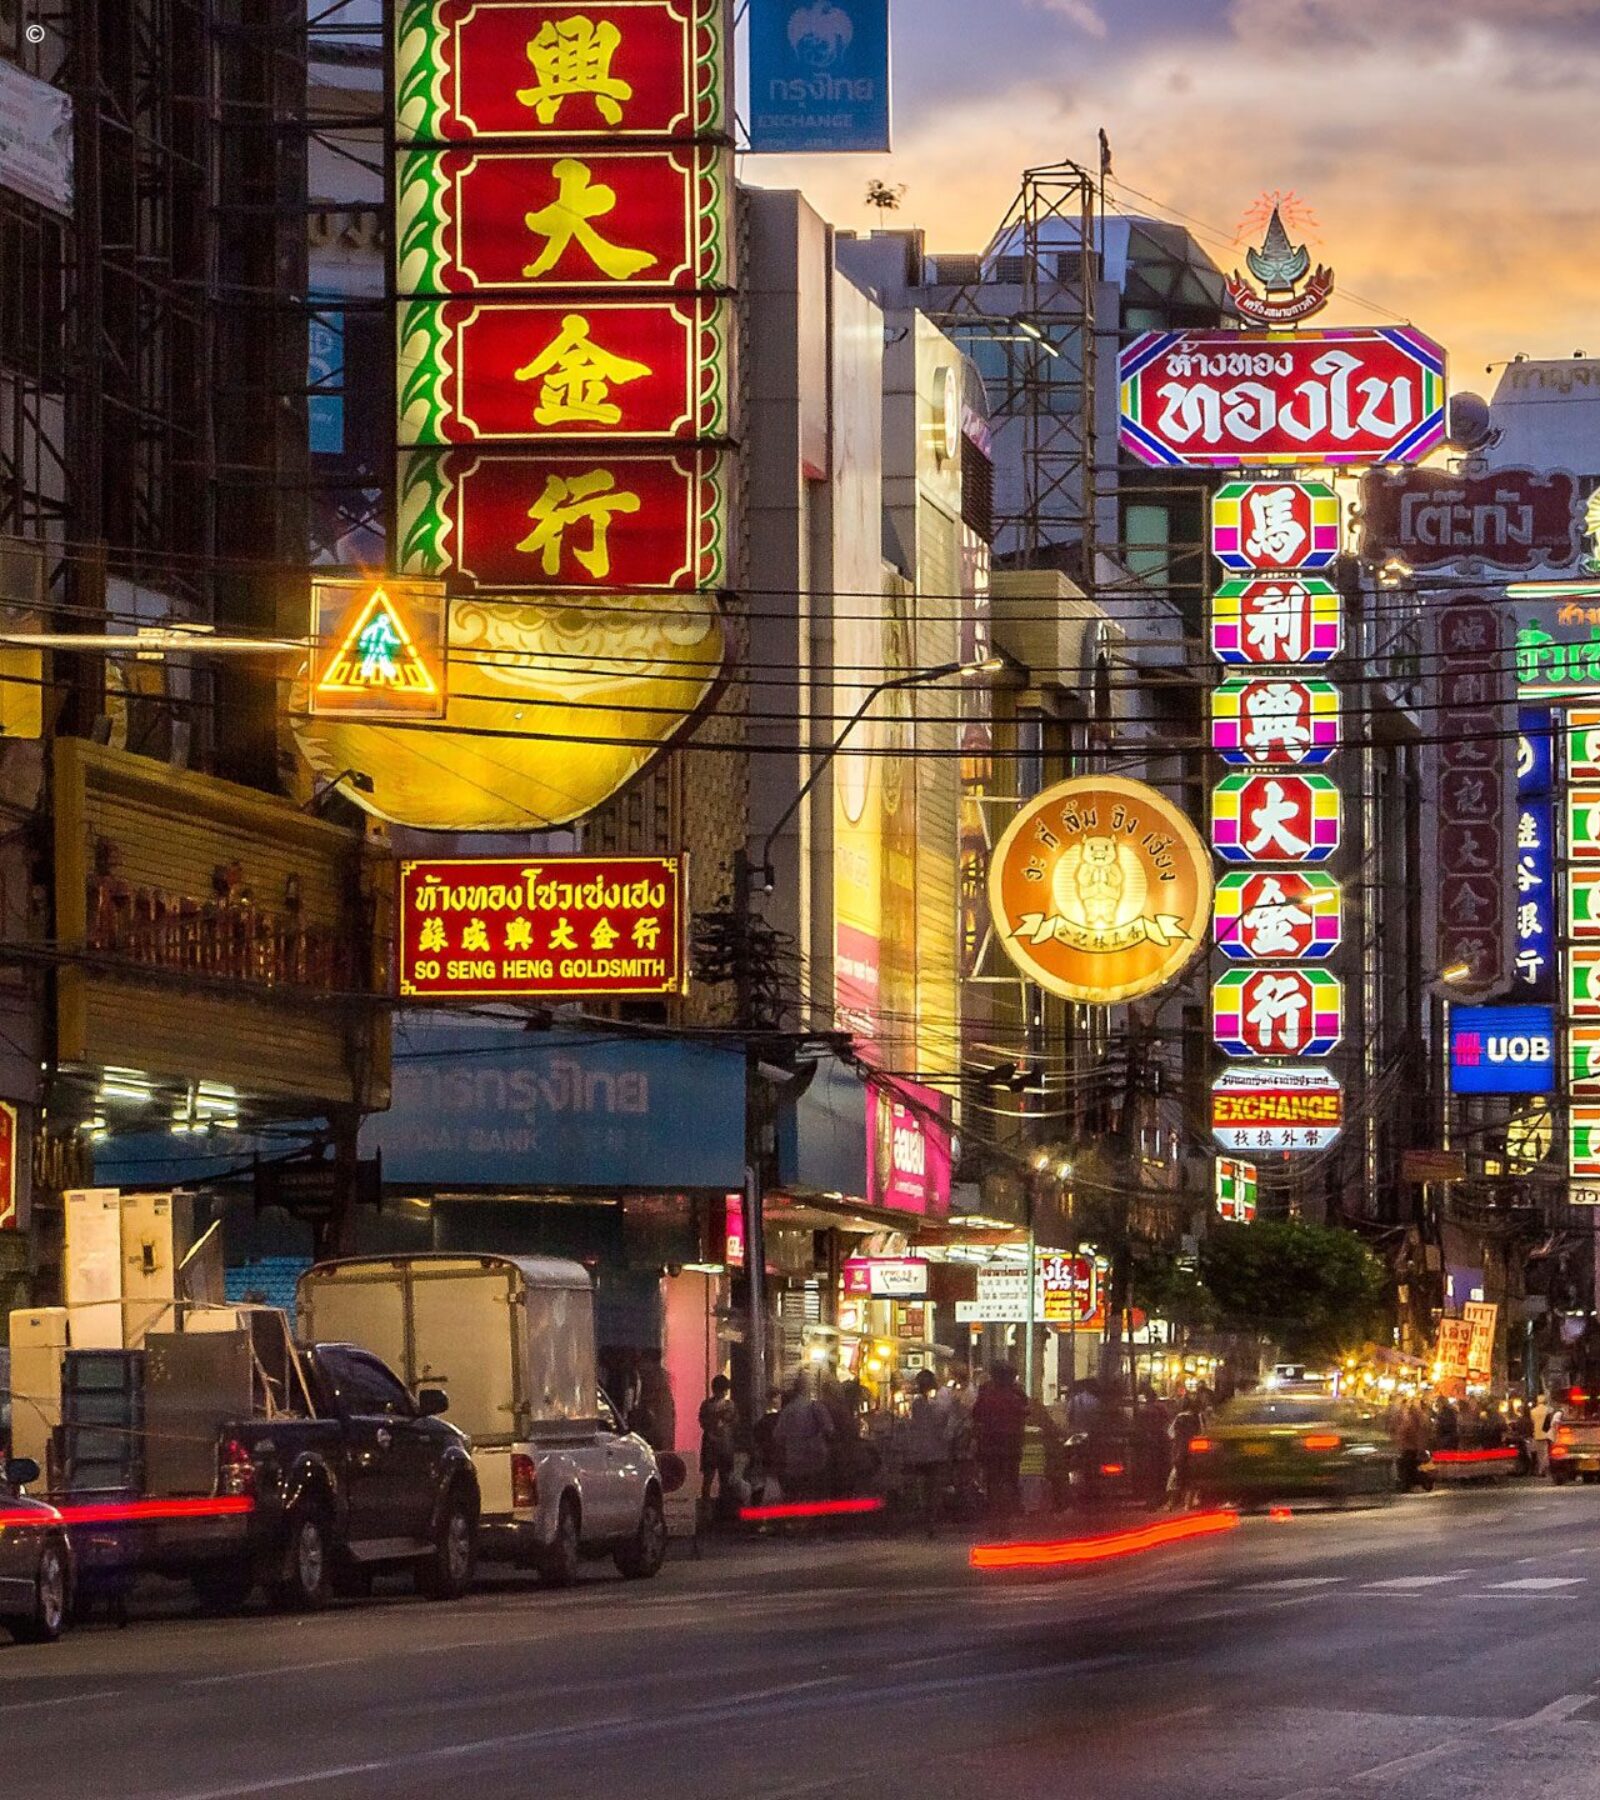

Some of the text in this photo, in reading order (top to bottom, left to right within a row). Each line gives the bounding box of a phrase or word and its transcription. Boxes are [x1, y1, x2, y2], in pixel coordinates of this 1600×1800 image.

[1166, 342, 1294, 378] ห้างทอง
[1156, 350, 1413, 443] ทองใบ
[1399, 489, 1534, 546] โต๊ะกัง
[414, 867, 666, 911] ห้างทองโซวเซ่งเฮง
[415, 958, 666, 979] SO SENG HENG GOLDSMITH
[1487, 1036, 1551, 1063] UOB
[1213, 1095, 1339, 1121] EXCHANGE
